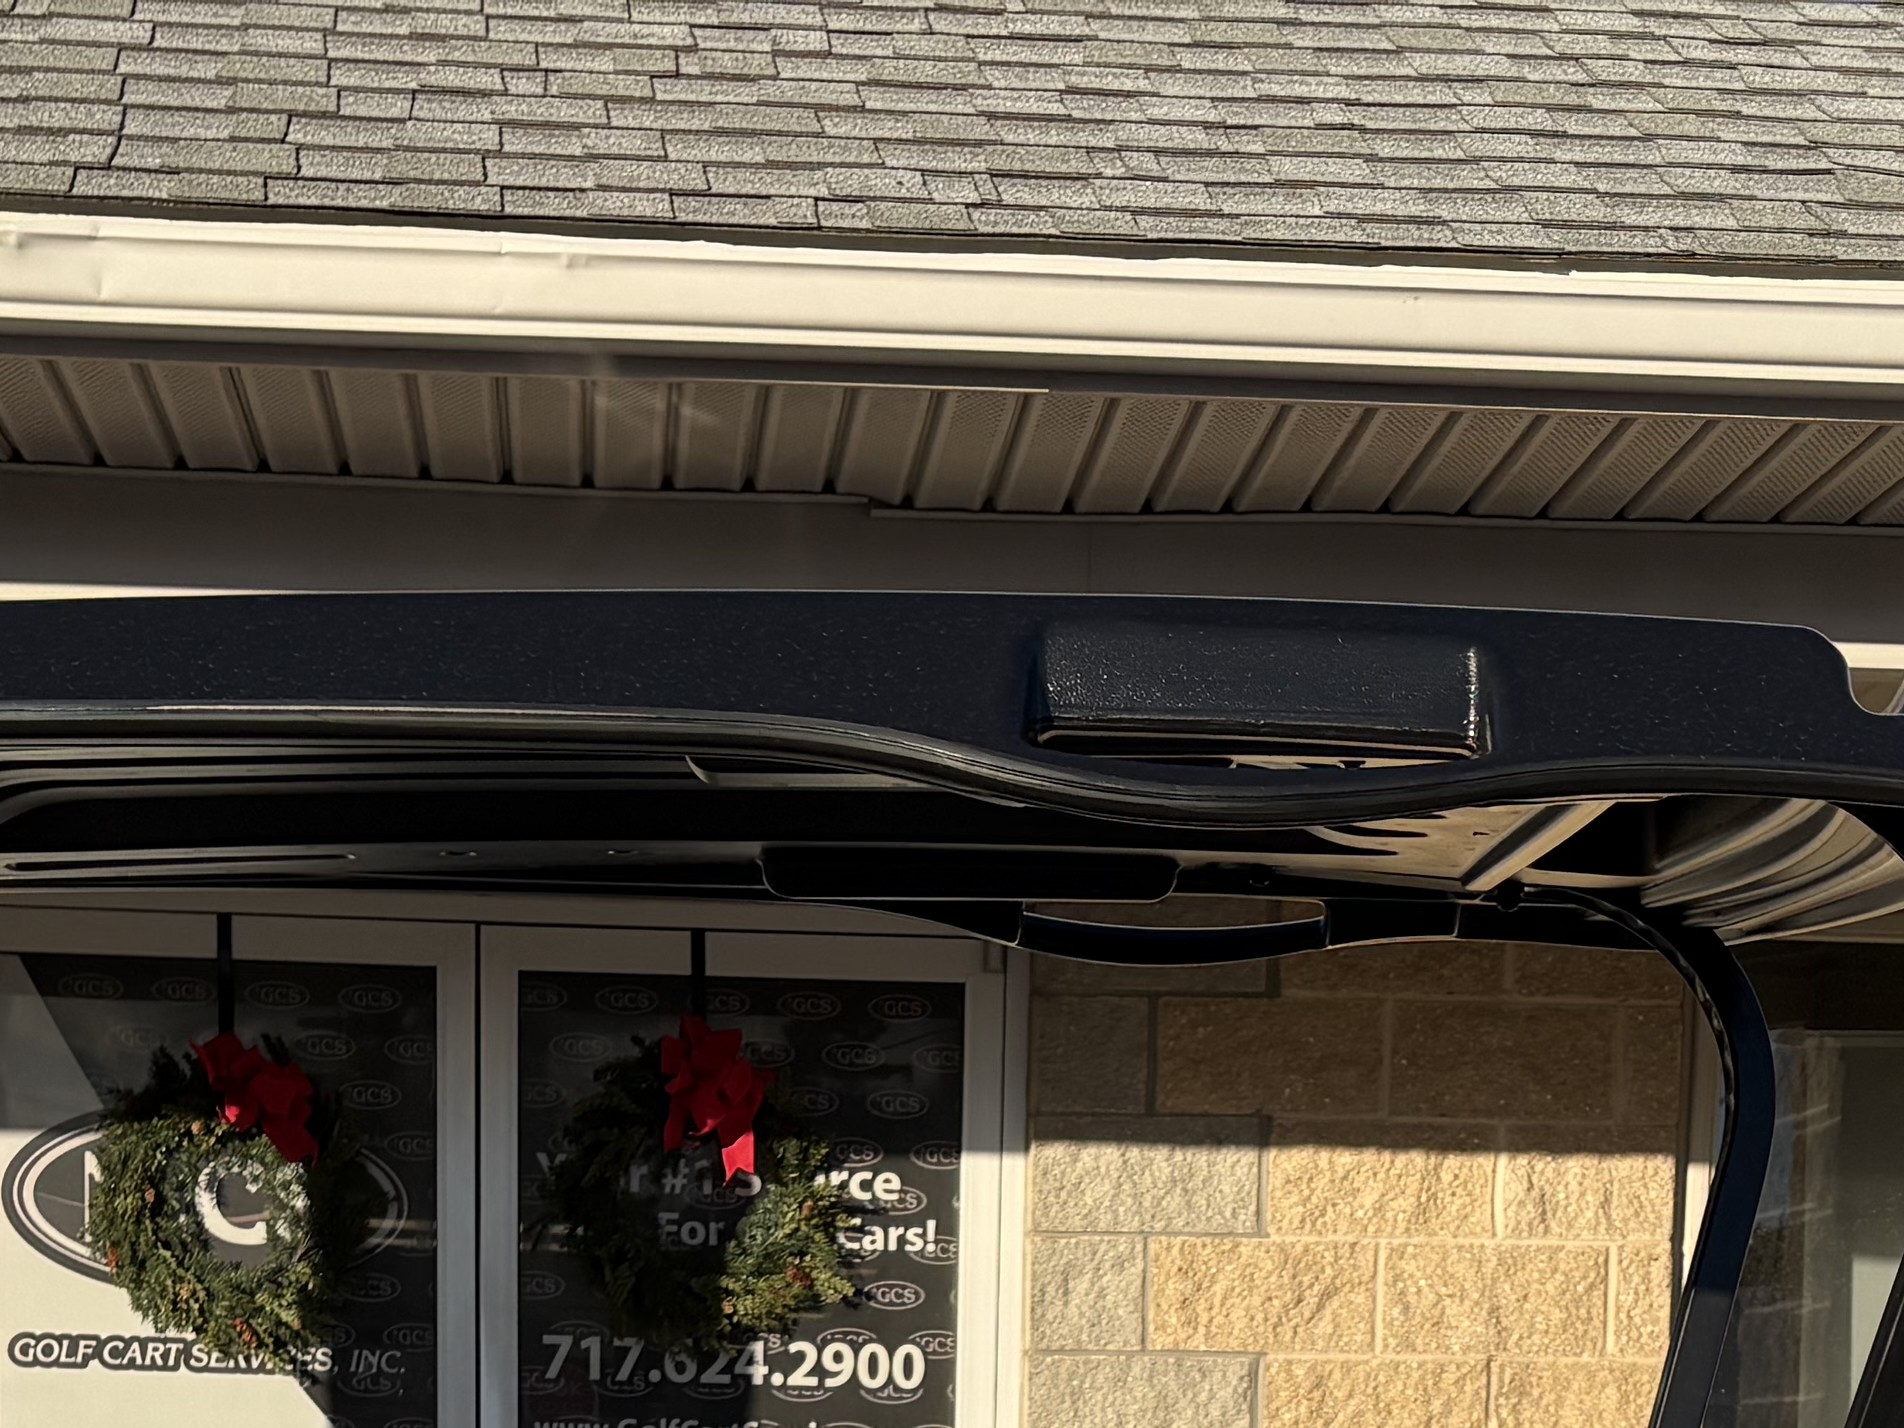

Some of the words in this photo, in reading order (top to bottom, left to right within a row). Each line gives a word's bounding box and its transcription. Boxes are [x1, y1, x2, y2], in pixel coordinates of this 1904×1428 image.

[14, 1339, 96, 1366] GOLF
[102, 1340, 183, 1368] CART
[542, 1334, 925, 1390] 717.624.2900
